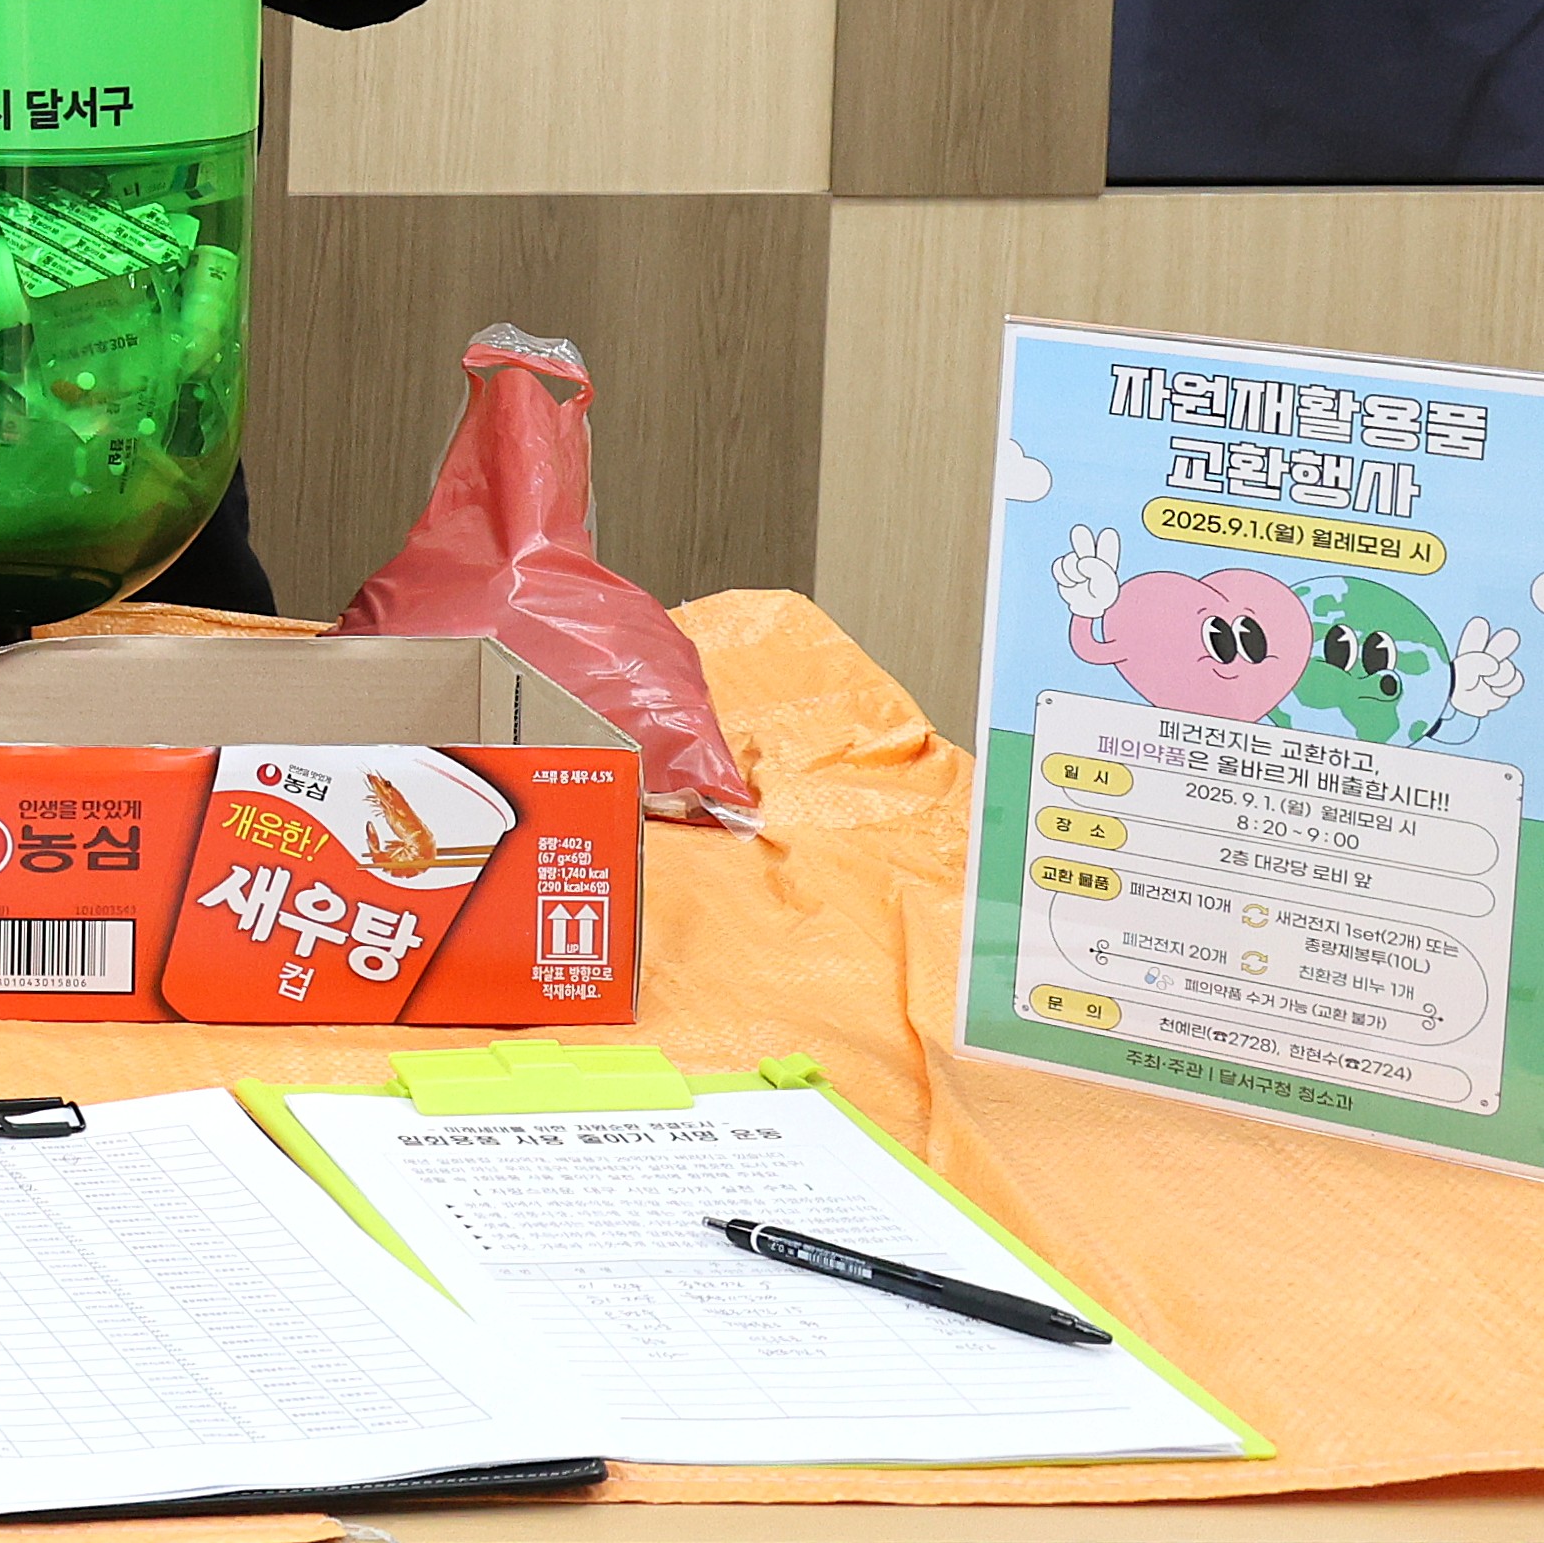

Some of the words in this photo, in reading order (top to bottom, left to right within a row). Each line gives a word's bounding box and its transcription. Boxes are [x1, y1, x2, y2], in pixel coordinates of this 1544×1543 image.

[26, 87, 134, 128] 달서구
[1109, 364, 1489, 460] 자원재활용품
[1166, 437, 1421, 518] 교환행사
[1161, 508, 1305, 547] 2025.9.1.(월)
[1312, 528, 1402, 560] 월례모임
[1410, 542, 1431, 564] 시
[1158, 719, 1272, 756] 폐건전지는
[1280, 738, 1380, 775] 교환하고,
[284, 774, 330, 802] 농심
[1098, 734, 1209, 771] 폐의약품은
[1216, 752, 1310, 789] 올바르게
[1317, 770, 1450, 813] 배출합시다!!
[19, 799, 78, 820] 인생을
[83, 799, 142, 820] 맛있게
[1280, 796, 1312, 819] (월)
[1321, 804, 1393, 832] 월례모임
[1399, 819, 1417, 837] 시
[18, 824, 141, 873] 농심
[222, 803, 330, 862] 개운한!
[589, 867, 609, 879] kcal
[1041, 865, 1074, 884] 교환
[1219, 847, 1249, 867] 2층
[1254, 852, 1308, 879] 대강당
[1312, 862, 1349, 886] 로비
[1354, 868, 1373, 889] 앞
[1129, 880, 1193, 907] 폐건전지
[1196, 891, 1231, 914] 10개
[197, 865, 424, 983] 새우탕
[1275, 911, 1341, 939] 새건전지
[1345, 918, 1421, 951] 1set(2개)
[1426, 934, 1459, 959] 또는
[567, 944, 579, 954] UP
[1122, 930, 1186, 959] 폐건전지
[1189, 942, 1228, 965] 20개
[1304, 936, 1430, 975] 종량제봉투(10L)
[277, 962, 314, 1002] 컵
[532, 966, 566, 981] 화살표
[569, 966, 613, 982] 방향으로
[542, 984, 601, 1000] 적재하세요.
[1298, 964, 1349, 988] 친환경
[1353, 973, 1384, 995] 비누
[1389, 979, 1414, 1002] 1개
[1184, 978, 1242, 1004] 폐의약품
[1247, 987, 1275, 1010] 수거
[1279, 993, 1307, 1015] 가능
[1312, 1001, 1346, 1026] (교환
[1351, 1007, 1387, 1030] 불가)
[1219, 1068, 1293, 1099] 달서구청
[1298, 1085, 1354, 1113] 청소과
[398, 1135, 501, 1146] 일회용품
[516, 1135, 565, 1146] 사용
[577, 1133, 655, 1144] 줄이기
[670, 1130, 719, 1142] 서명
[731, 1128, 783, 1140] 운동
